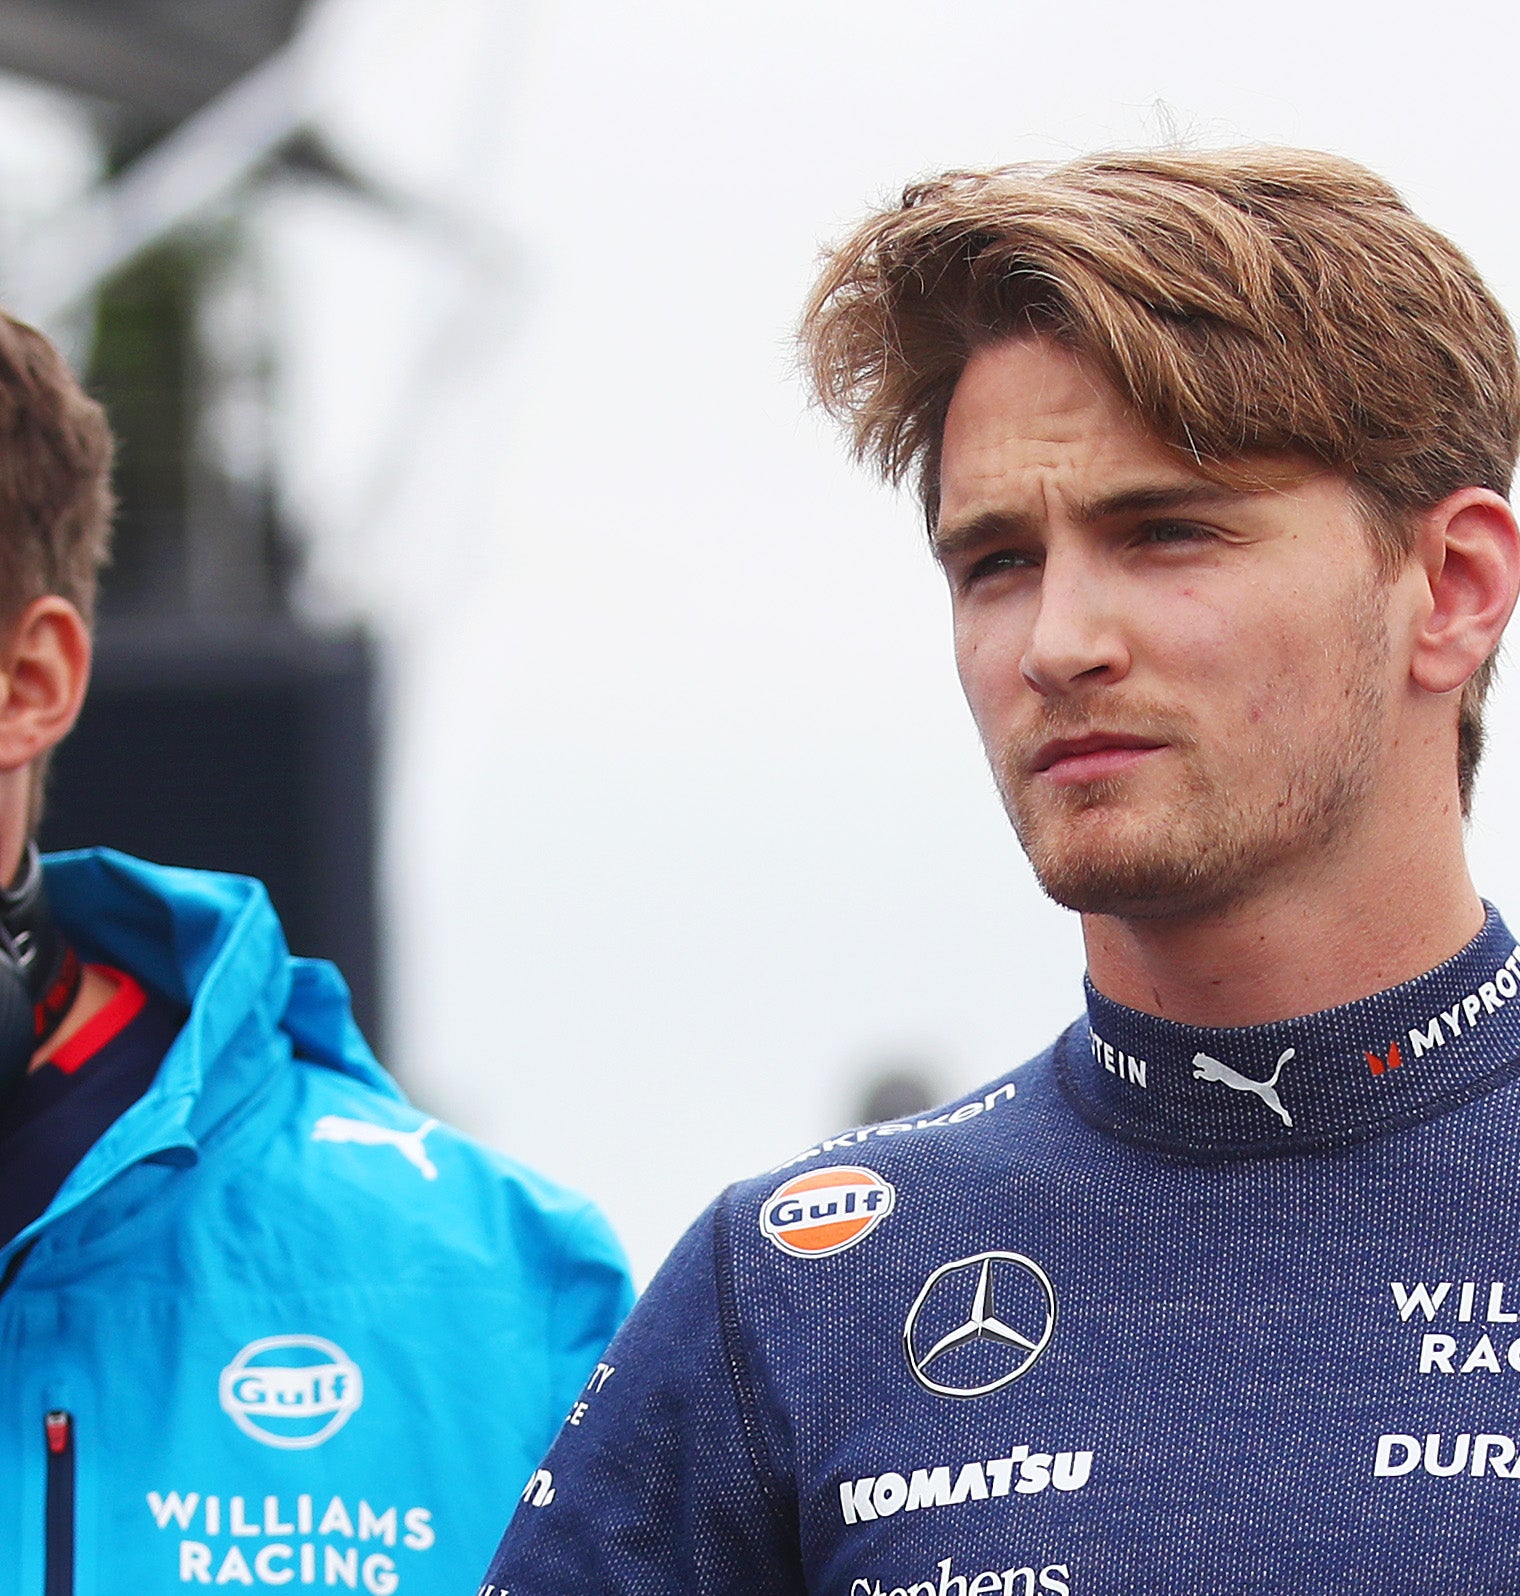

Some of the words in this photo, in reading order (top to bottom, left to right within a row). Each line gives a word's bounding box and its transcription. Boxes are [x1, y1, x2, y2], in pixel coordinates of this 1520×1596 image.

[1089, 1026, 1147, 1088] TEIN
[823, 1083, 1017, 1152] kraken
[769, 1188, 884, 1226] Gulf
[231, 1374, 349, 1405] Gulf
[839, 1444, 1094, 1526] KOMATSU
[145, 1490, 436, 1551] WILLIAMS
